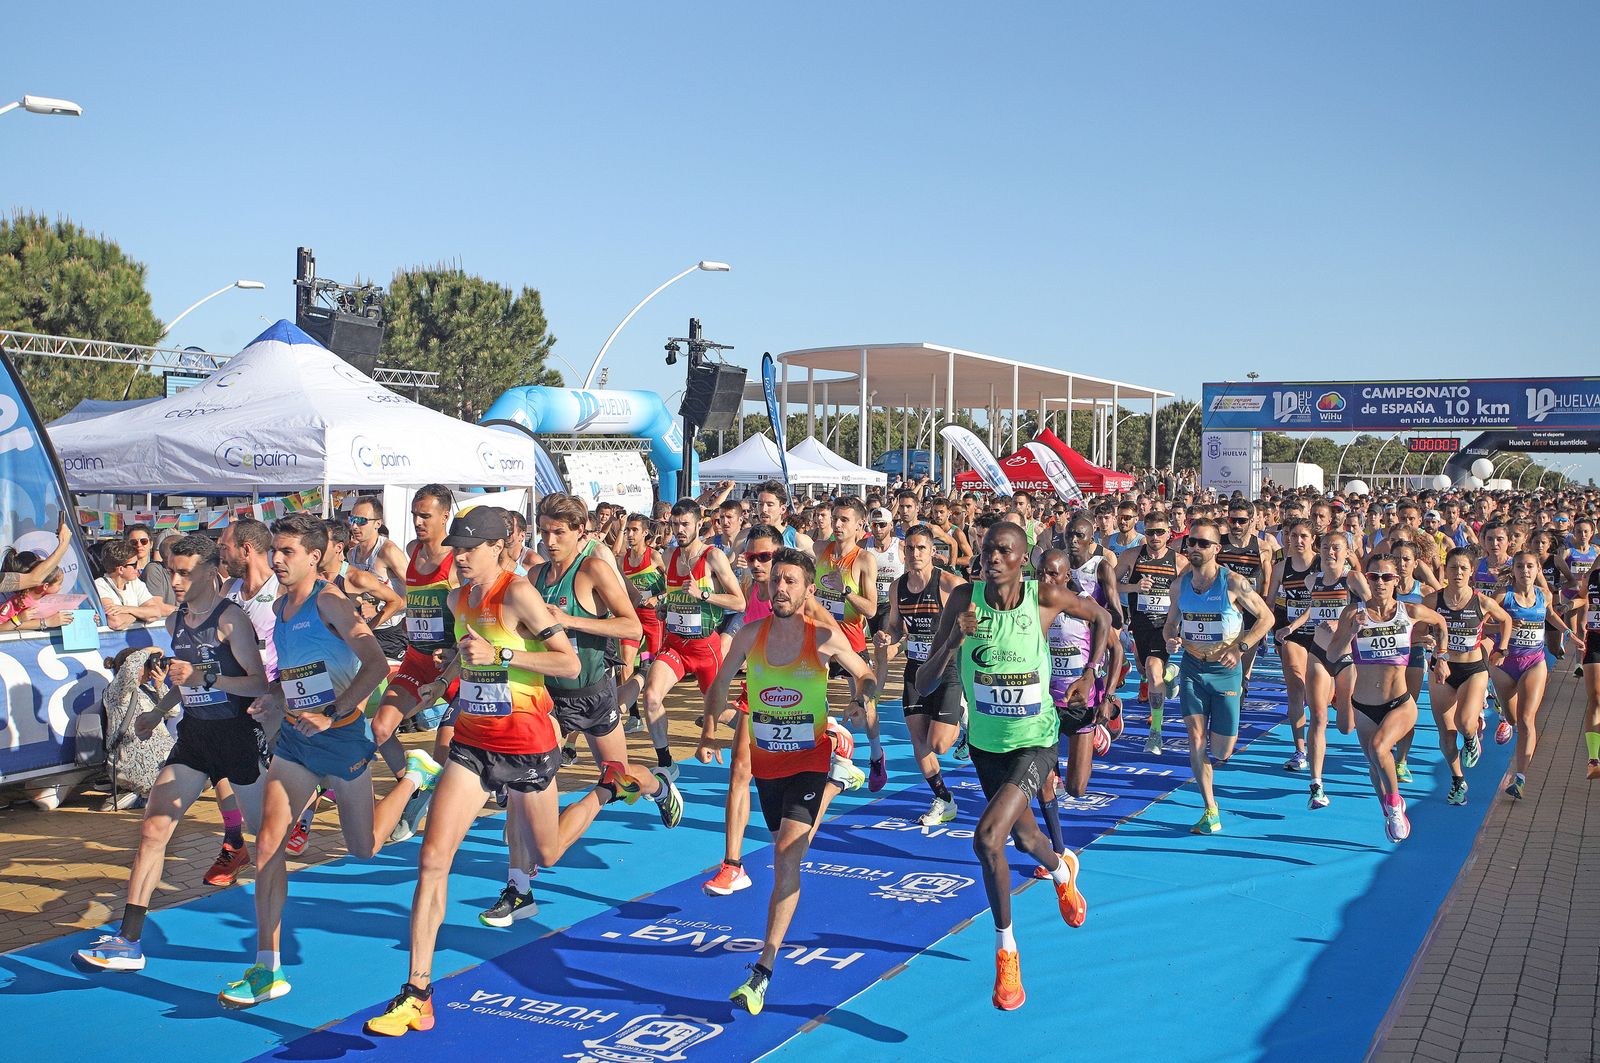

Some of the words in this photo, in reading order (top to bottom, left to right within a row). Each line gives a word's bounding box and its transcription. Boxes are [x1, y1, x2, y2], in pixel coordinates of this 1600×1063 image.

[1361, 386, 1471, 399] CAMPEONATO
[600, 398, 632, 416] HUELVA
[1361, 402, 1378, 414] de
[1381, 400, 1436, 414] ESPAÑA
[1445, 399, 1470, 415] 10
[1476, 398, 1510, 415] km
[1554, 394, 1600, 408] HUELVA
[1320, 412, 1342, 421] WiHu
[1432, 416, 1470, 424] Absoluto
[1471, 417, 1477, 425] y
[1479, 416, 1510, 424] Master
[63, 454, 105, 474] paim
[225, 445, 298, 470] Cepaim
[961, 481, 1049, 491] SPORANIACS
[1149, 596, 1162, 605] 37
[678, 615, 684, 625] 3
[1319, 608, 1337, 618] 401
[415, 619, 429, 631] 10
[1198, 622, 1205, 633] 9
[1516, 630, 1537, 640] 426
[1370, 636, 1397, 650] 409
[991, 655, 1027, 663] MENORCA
[295, 681, 306, 696] 8
[473, 685, 484, 701] 2
[763, 692, 800, 703] Serrano
[989, 688, 1024, 704] 107
[772, 726, 793, 740] 22
[800, 860, 894, 878] HUELV
[656, 917, 733, 932] original
[446, 1000, 471, 1010] de
[468, 988, 620, 1025] HUELVA
[472, 1005, 595, 1032] Ayuntamiento
